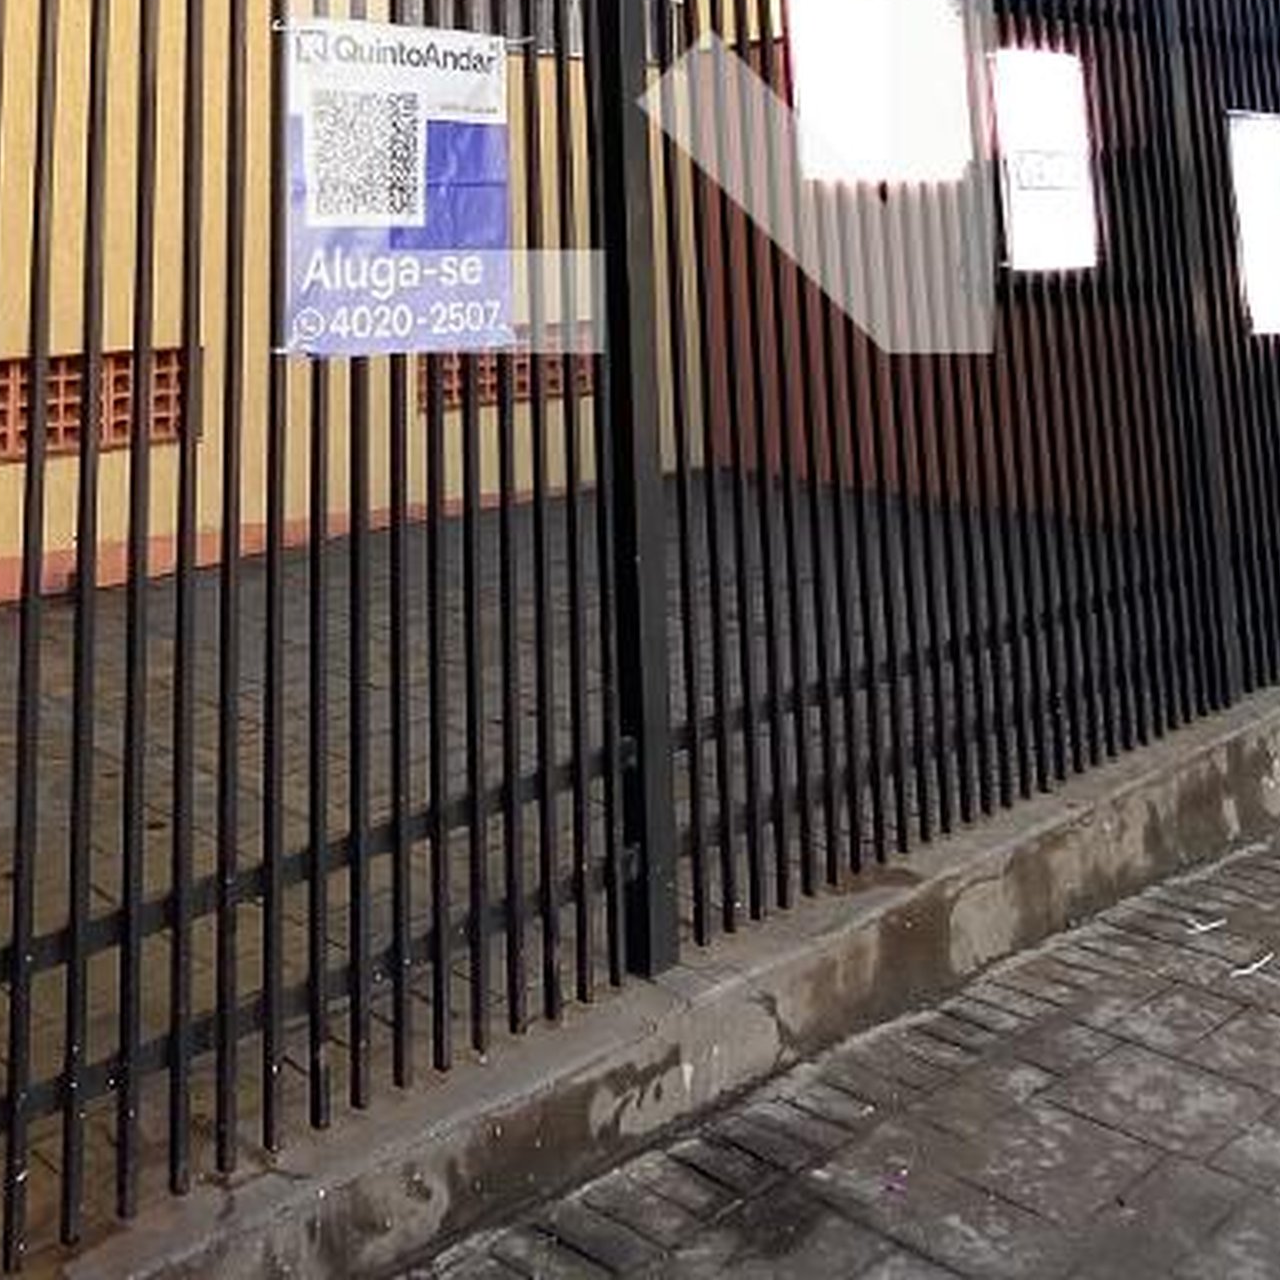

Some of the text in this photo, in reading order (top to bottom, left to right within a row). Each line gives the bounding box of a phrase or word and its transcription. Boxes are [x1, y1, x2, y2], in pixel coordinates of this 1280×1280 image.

[335, 35, 497, 74] QuintoAndar
[300, 248, 484, 300] Aluga-se
[328, 301, 501, 338] 4020-2507
